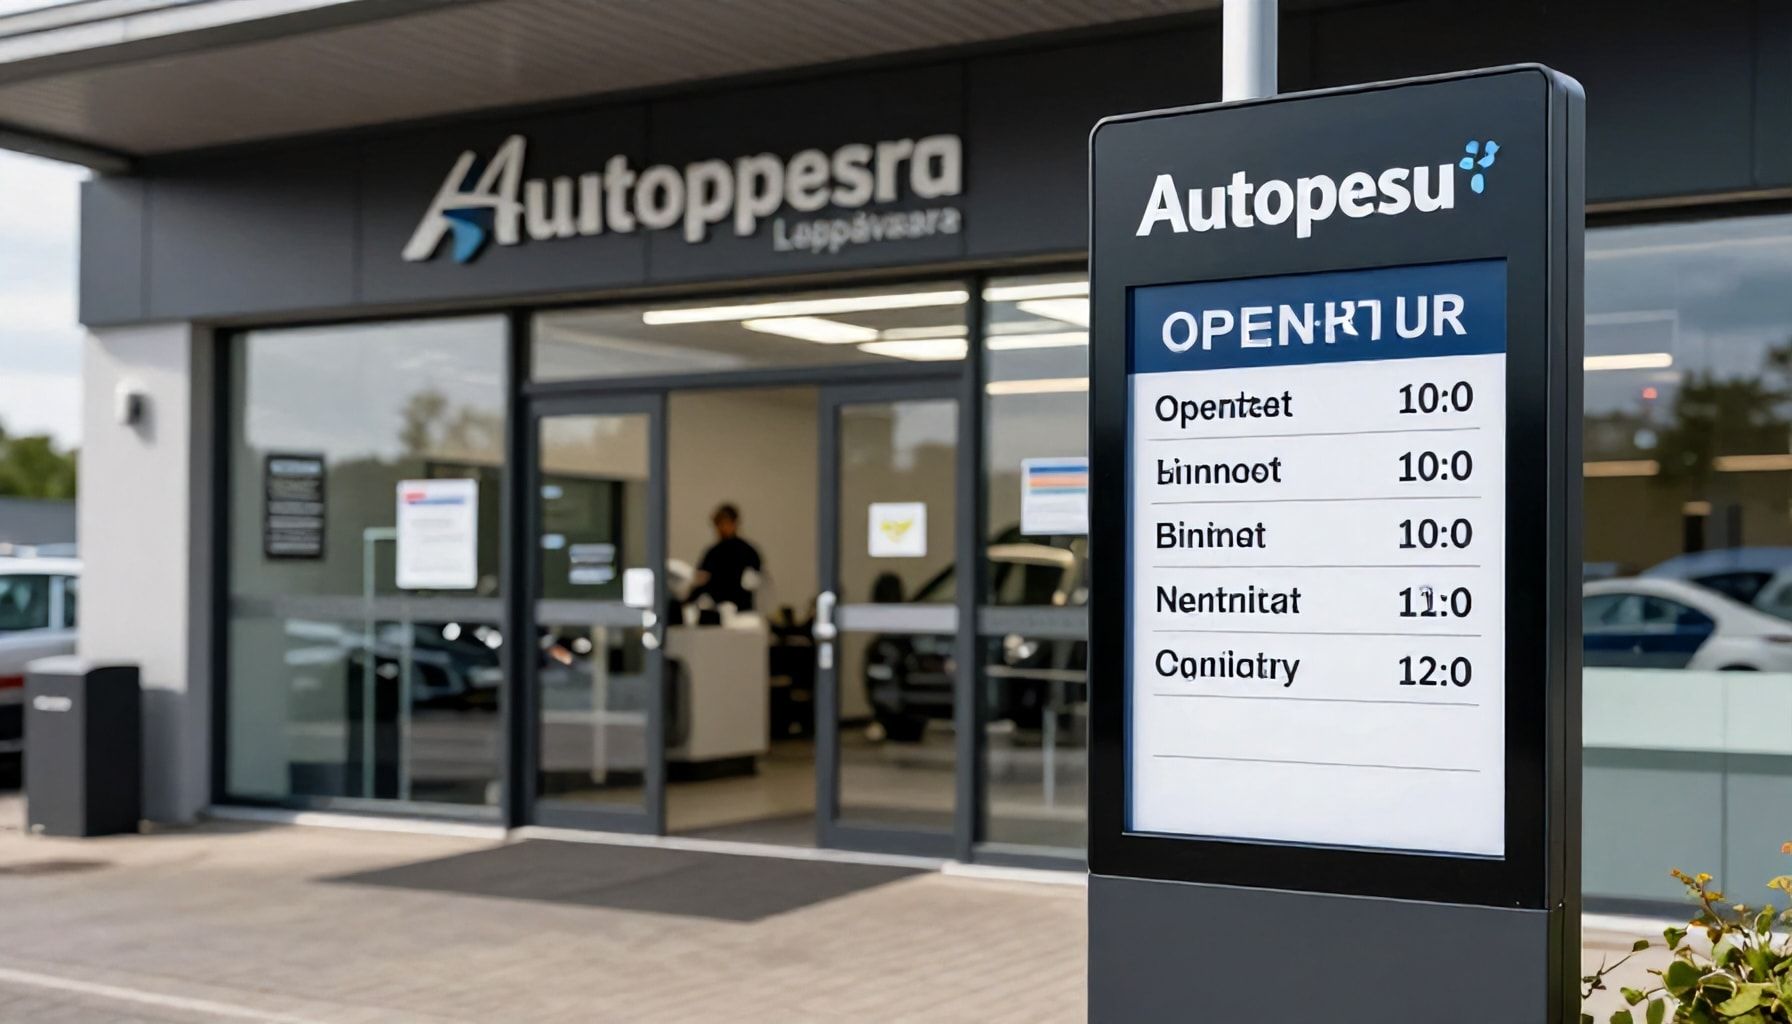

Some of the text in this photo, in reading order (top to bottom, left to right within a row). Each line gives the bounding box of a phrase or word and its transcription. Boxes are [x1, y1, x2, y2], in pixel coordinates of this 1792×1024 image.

[1135, 163, 1455, 239] Autopesu
[1399, 380, 1474, 414] 10:0
[1398, 450, 1473, 482] 10:0
[1399, 518, 1473, 549] 10:0
[1399, 655, 1472, 688] 12:0
